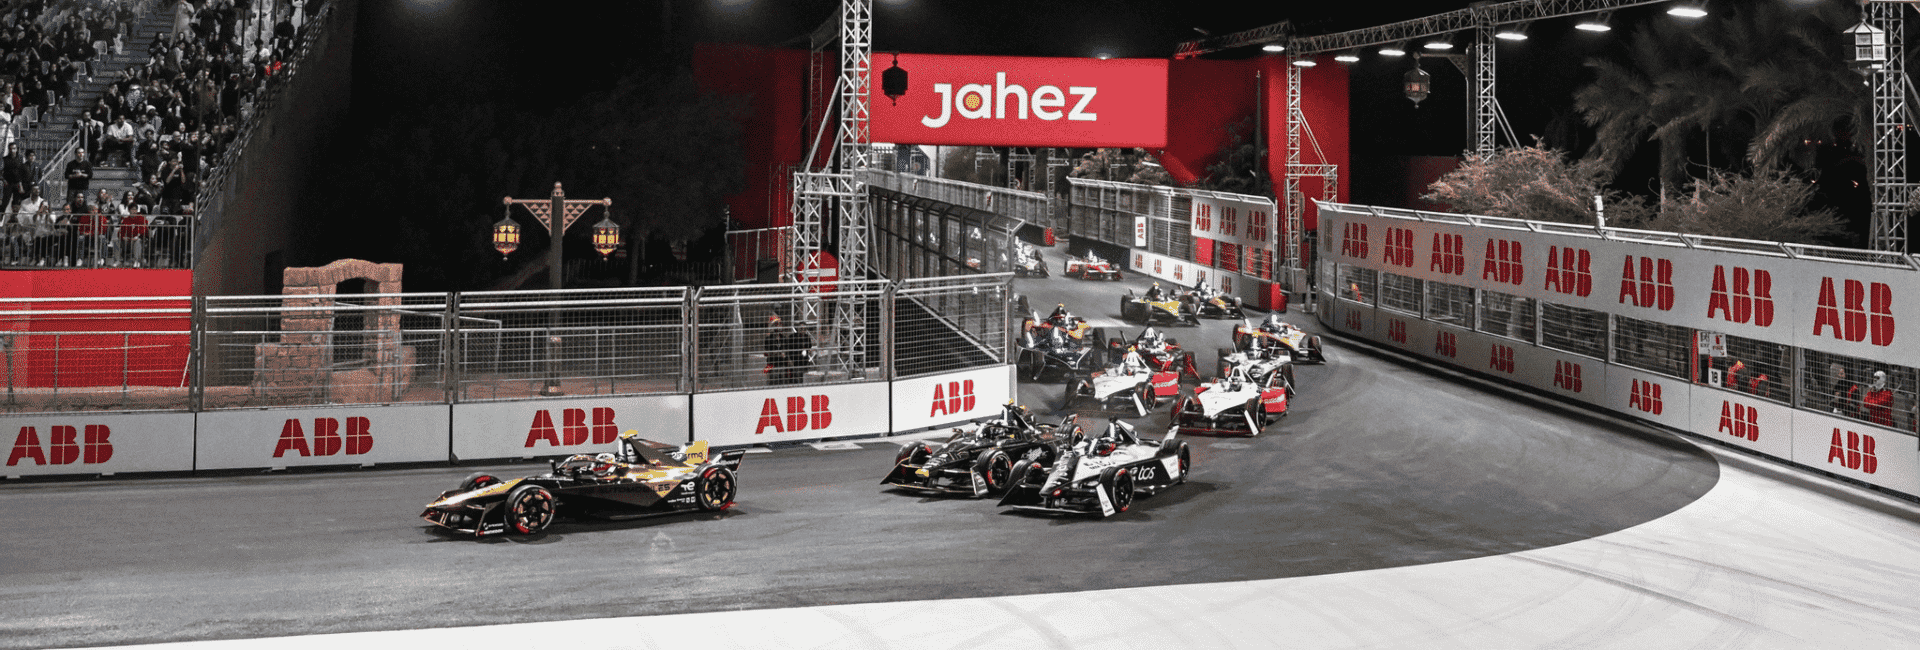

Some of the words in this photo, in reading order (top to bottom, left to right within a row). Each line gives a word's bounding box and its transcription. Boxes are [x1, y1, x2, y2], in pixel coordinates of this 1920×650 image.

[1342, 222, 1369, 260] ABB
[1384, 227, 1415, 268] ABB
[1431, 232, 1465, 277] ABB
[1483, 238, 1524, 286] ABB
[1545, 245, 1593, 298] ABB
[1619, 255, 1675, 311] ABB
[1707, 265, 1775, 328] ABB
[1388, 318, 1407, 345] ABB
[1813, 276, 1896, 347] ABB
[1436, 330, 1457, 359] ABB
[1490, 343, 1515, 374] ABB
[1554, 360, 1583, 393] ABB
[1629, 378, 1663, 416] ABB
[756, 395, 833, 434] ABB
[931, 379, 976, 417] ABB
[273, 416, 374, 458] ABB
[524, 407, 619, 447] ABB
[1719, 400, 1760, 442] ABB
[6, 424, 113, 467] ABB
[1827, 428, 1878, 474] ABB
